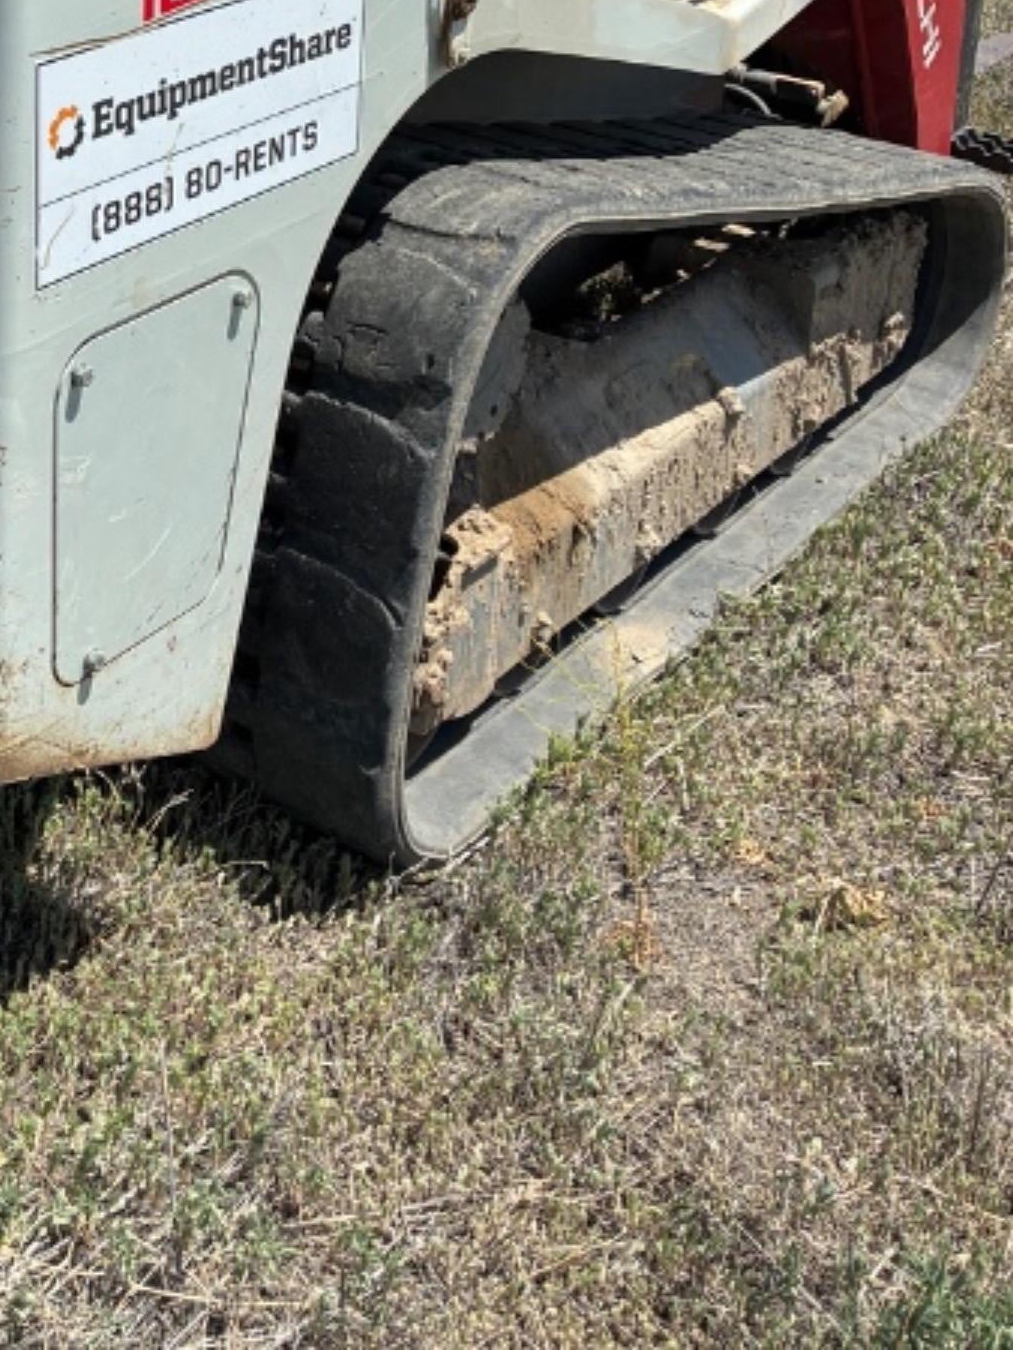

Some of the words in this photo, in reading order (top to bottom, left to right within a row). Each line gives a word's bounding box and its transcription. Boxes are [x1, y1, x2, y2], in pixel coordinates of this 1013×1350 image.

[91, 22, 352, 139] EquipmentShare
[90, 175, 174, 243] (888)
[184, 121, 319, 200] 80-RENTS
